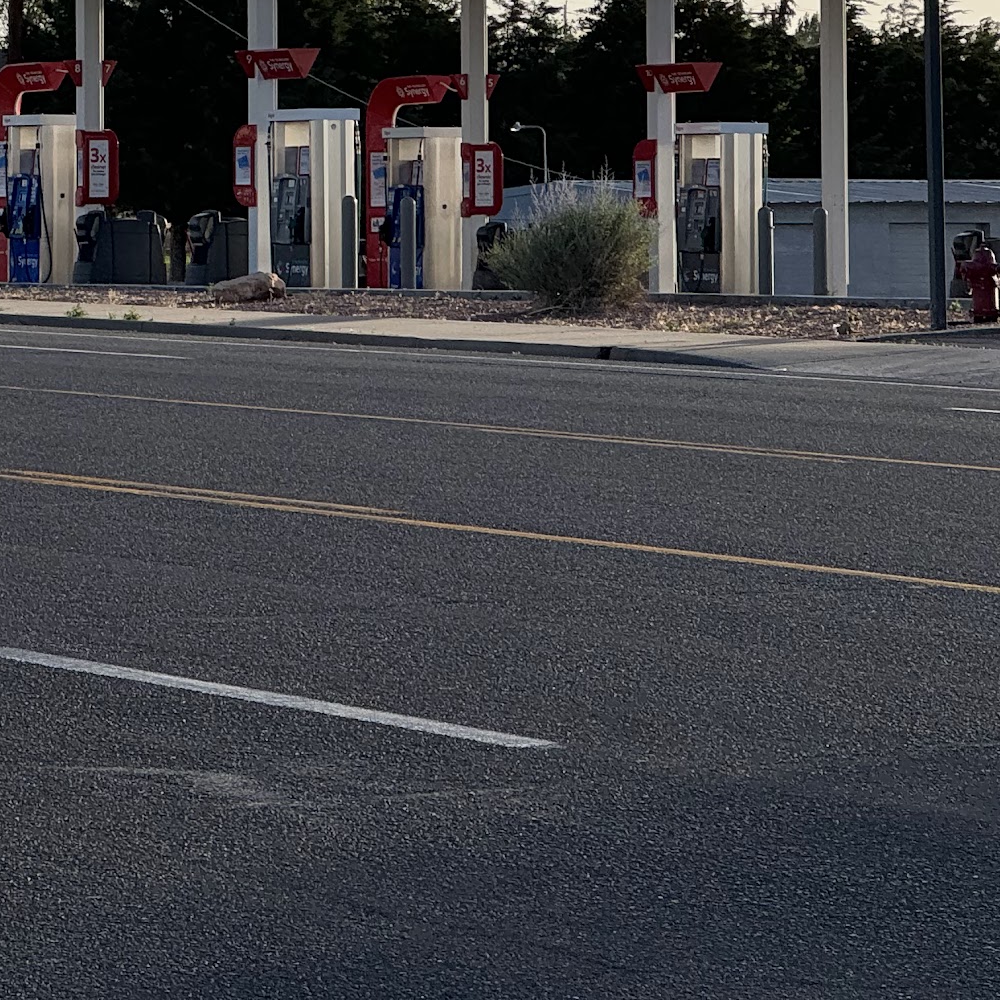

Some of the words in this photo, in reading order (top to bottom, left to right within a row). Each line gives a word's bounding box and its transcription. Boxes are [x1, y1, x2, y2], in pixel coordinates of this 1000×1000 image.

[74, 63, 81, 73] 8
[105, 64, 111, 73] 7
[460, 77, 465, 86] 6
[488, 78, 493, 88] 5
[90, 148, 106, 163] 3x
[476, 158, 491, 173] 3x
